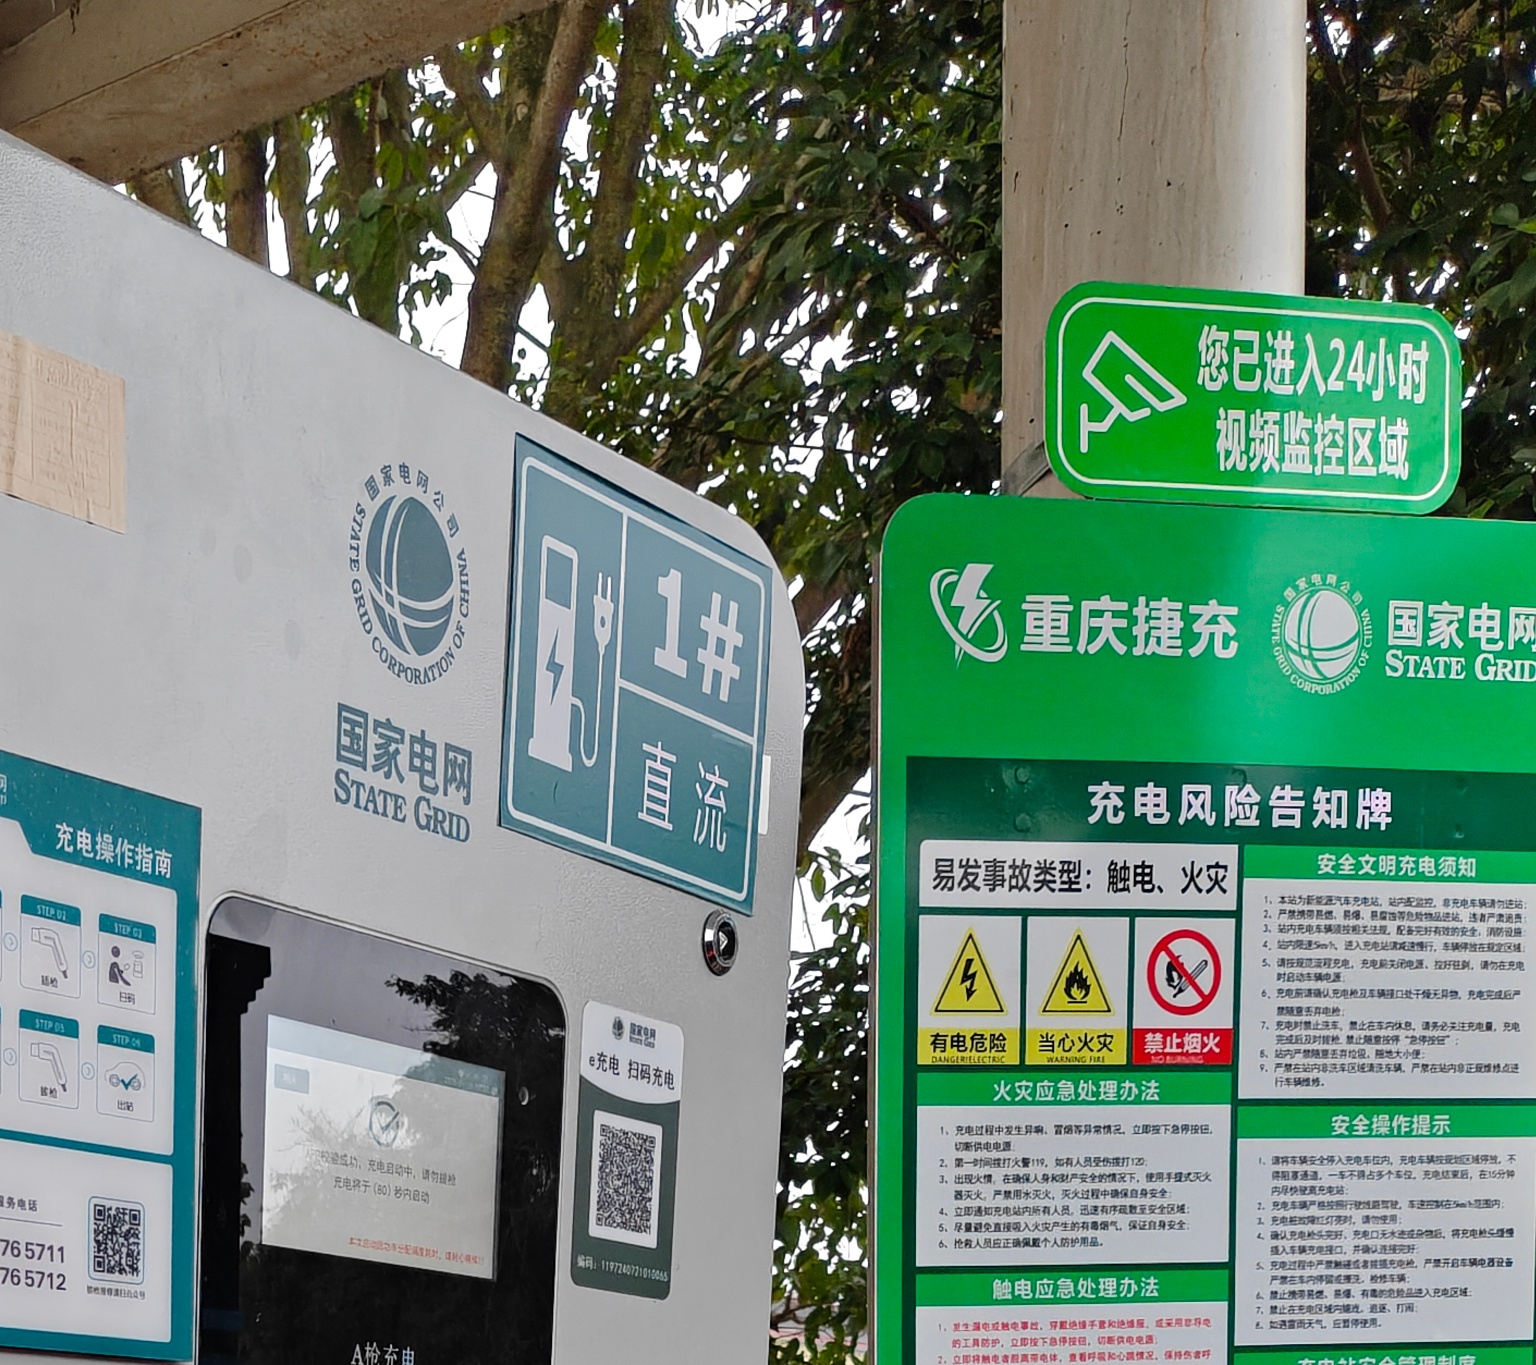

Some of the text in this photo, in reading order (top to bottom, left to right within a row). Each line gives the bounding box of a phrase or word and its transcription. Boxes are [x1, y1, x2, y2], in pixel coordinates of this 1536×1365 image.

[1197, 325, 1429, 404] 您已进入24小时
[1216, 408, 1409, 481] 视频监控区域
[364, 462, 461, 538] 国家电网公司
[349, 502, 471, 686] STATE GRID CORPORATION OF CHINA
[654, 568, 744, 702] 1#
[1020, 595, 1240, 660] 重庆捷充
[1271, 604, 1285, 644] STATE
[1360, 608, 1373, 648] CHINA
[1388, 600, 1536, 653] 国家电网
[1273, 646, 1293, 676] GRID
[1385, 649, 1536, 683] STATE GRID
[1290, 666, 1361, 695] CORPORATION
[336, 702, 473, 806] 国家电网
[333, 766, 471, 844] STATE GRID
[637, 740, 730, 853] 直流
[1087, 783, 1394, 833] 充电风险告知牌
[55, 822, 173, 881] 充电操作指南
[1318, 852, 1476, 880] 安全文明充电须知
[932, 857, 1228, 896] 易发事故类型：触电、火灾
[36, 904, 56, 917] STEP
[114, 921, 132, 934] STEP
[35, 1018, 54, 1031] STEP
[112, 1033, 130, 1046] STEP
[930, 1032, 1007, 1053] 有电危险
[1039, 1032, 1114, 1054] 当心火灾
[1144, 1032, 1221, 1054] 禁止烟火
[589, 1050, 675, 1091] e充电 扫码充电
[993, 1078, 1160, 1102] 火灾应急处理办法
[1330, 1114, 1451, 1139] 安全操作提示
[24, 1242, 65, 1264] 5711
[24, 1270, 67, 1291] 5712
[992, 1277, 1159, 1302] 触电应急处理办法
